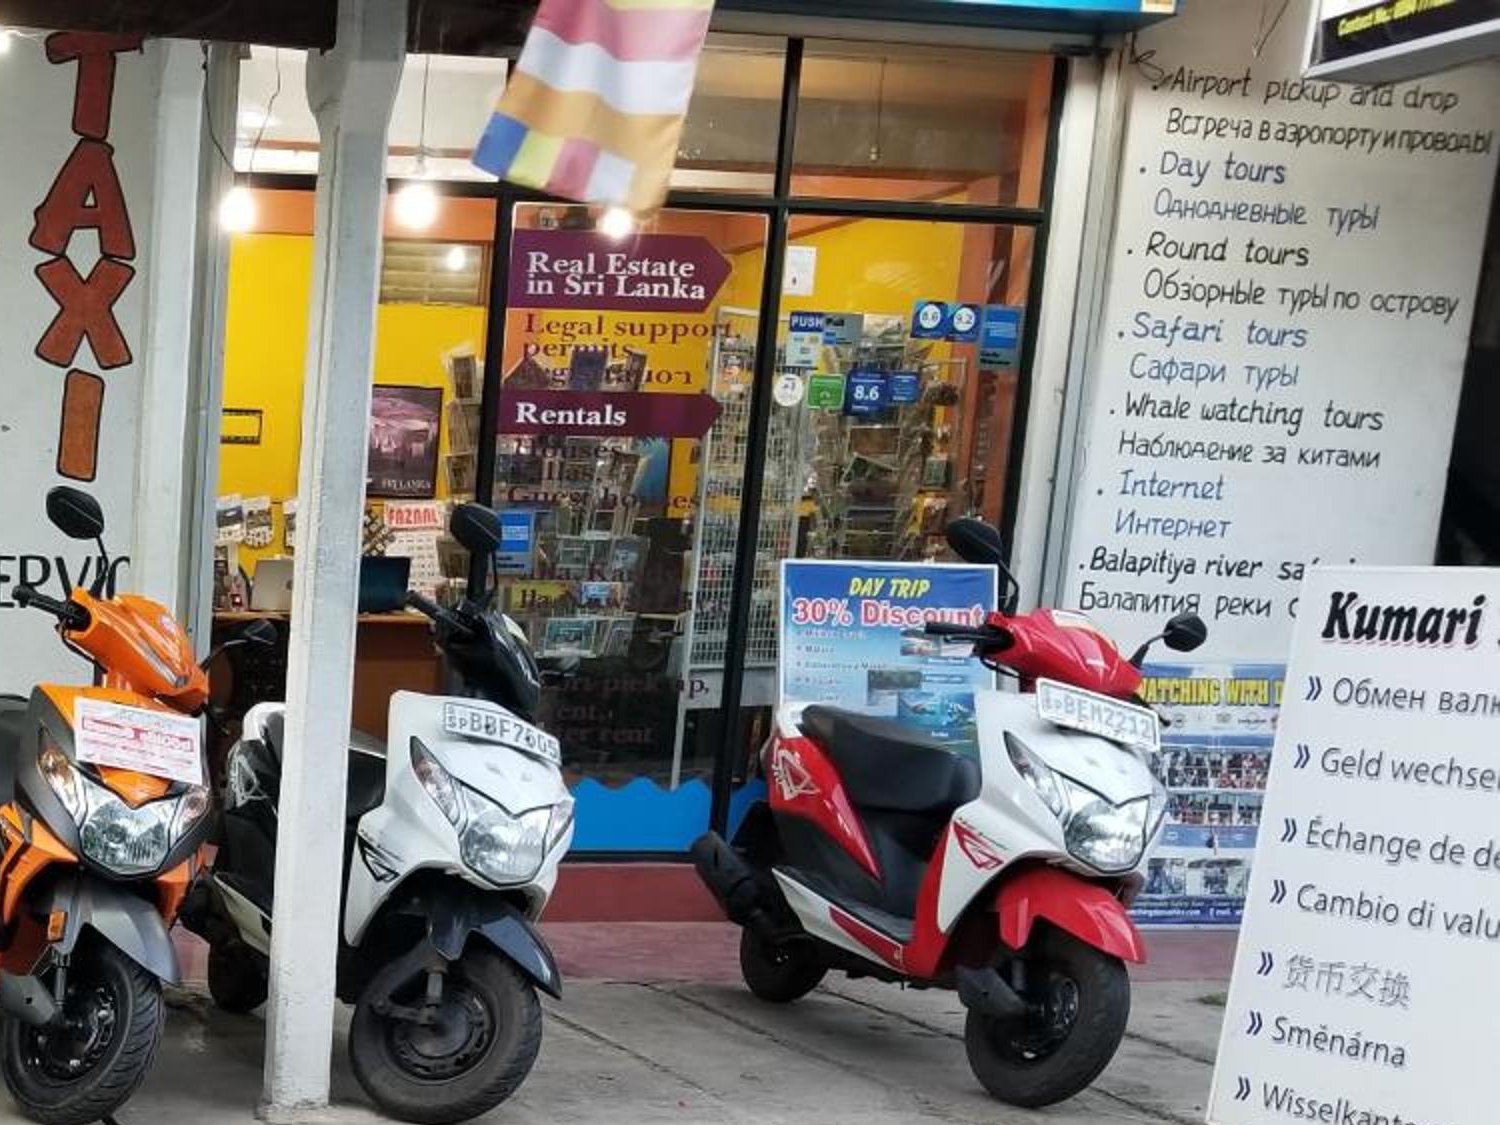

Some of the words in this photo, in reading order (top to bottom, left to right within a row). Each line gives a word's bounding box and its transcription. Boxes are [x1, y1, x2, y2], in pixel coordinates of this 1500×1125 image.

[1170, 65, 1252, 99] Airport
[1350, 83, 1394, 107] and
[1403, 85, 1459, 114] drop
[1166, 107, 1253, 140] Встреча
[1160, 151, 1210, 187] Day
[1225, 152, 1286, 185] tours
[1154, 187, 1307, 225] Однодневные
[1327, 204, 1381, 236] туры
[29, 31, 144, 482] TAXI
[527, 252, 596, 276] Real
[606, 253, 696, 279] Estate
[1145, 231, 1227, 262] Round
[1245, 238, 1310, 267] tours
[526, 276, 554, 296] in
[564, 274, 605, 296] Sri
[616, 276, 706, 300] Lanka
[1143, 268, 1265, 305] Обзорные
[1279, 283, 1330, 316] туры
[1332, 290, 1360, 310] по
[1370, 292, 1460, 325] острову
[524, 314, 603, 343] Legal
[1131, 312, 1224, 348] Safari
[1247, 319, 1309, 347] tours
[1129, 353, 1226, 387] Сафари
[1244, 364, 1300, 389] туры
[853, 385, 880, 401] 8.6
[515, 402, 627, 427] Rentals
[1125, 391, 1191, 420] Whale
[1201, 398, 1304, 436] watching
[1323, 400, 1384, 431] tours
[1118, 430, 1254, 464] Наблюдение
[1261, 445, 1286, 466] за
[1297, 448, 1381, 469] китами
[1118, 469, 1225, 501] Internet
[1114, 508, 1232, 540] Интернет
[1089, 546, 1196, 584] Balapitiya
[1205, 553, 1264, 579] river
[849, 577, 882, 597] DAY
[889, 578, 932, 599] TRIP
[1079, 581, 1201, 614] Балапития
[1214, 594, 1272, 620] реки
[792, 597, 854, 627] 30%
[860, 599, 986, 629] Discount
[1321, 590, 1487, 646] Kumari
[1332, 677, 1426, 710] Обмен
[1320, 746, 1384, 778] Geld
[1390, 757, 1500, 791] wechse
[1305, 815, 1421, 865] Échange
[1429, 833, 1467, 866] de
[1297, 883, 1399, 923] Cambio
[1408, 900, 1435, 930] di
[1283, 953, 1412, 1009] 货币交换
[1271, 1015, 1406, 1067] Směnárna
